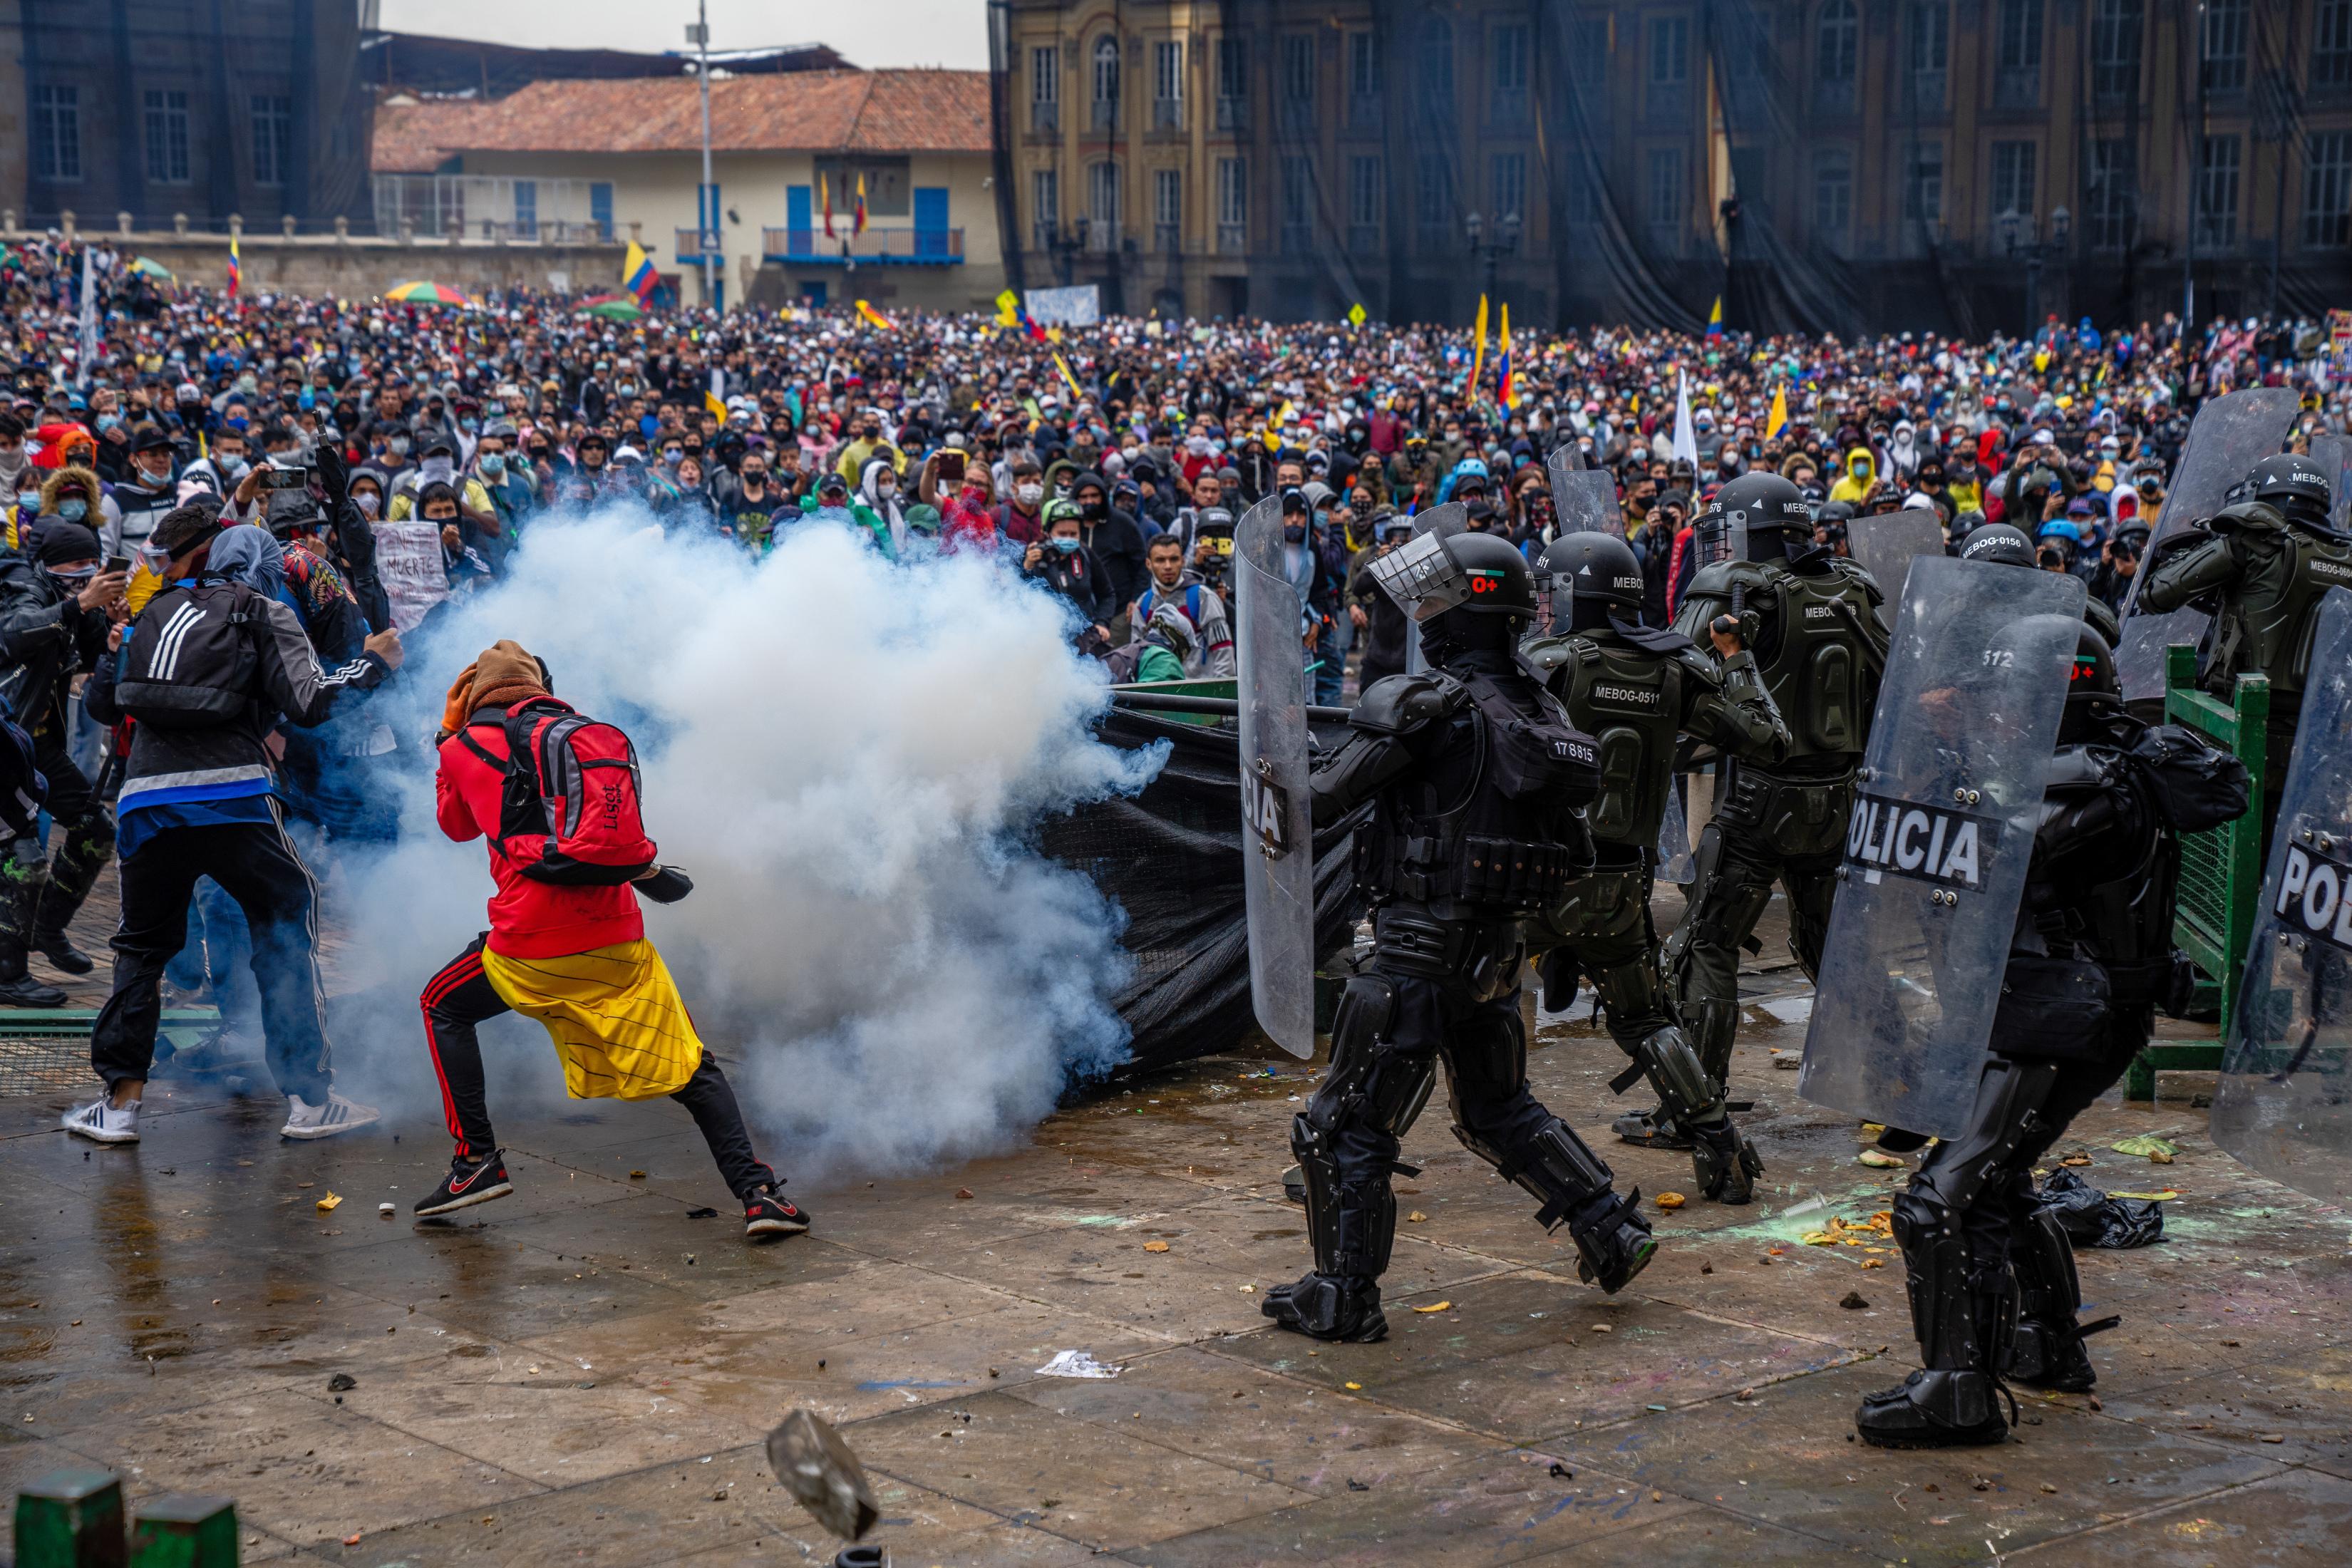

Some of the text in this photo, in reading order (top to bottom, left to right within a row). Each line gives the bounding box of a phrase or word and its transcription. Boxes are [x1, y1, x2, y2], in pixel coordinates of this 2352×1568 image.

[1708, 502, 1722, 513] 576
[1783, 502, 1810, 514] MEBO
[1963, 537, 2021, 559] MEBOG-0156
[387, 555, 435, 579] MUERTE
[1537, 556, 1549, 569] 511
[1983, 650, 2015, 668] 512
[1595, 686, 1660, 704] MEBOG-0511
[1554, 741, 1594, 763] 178815
[603, 784, 619, 831] Ligot
